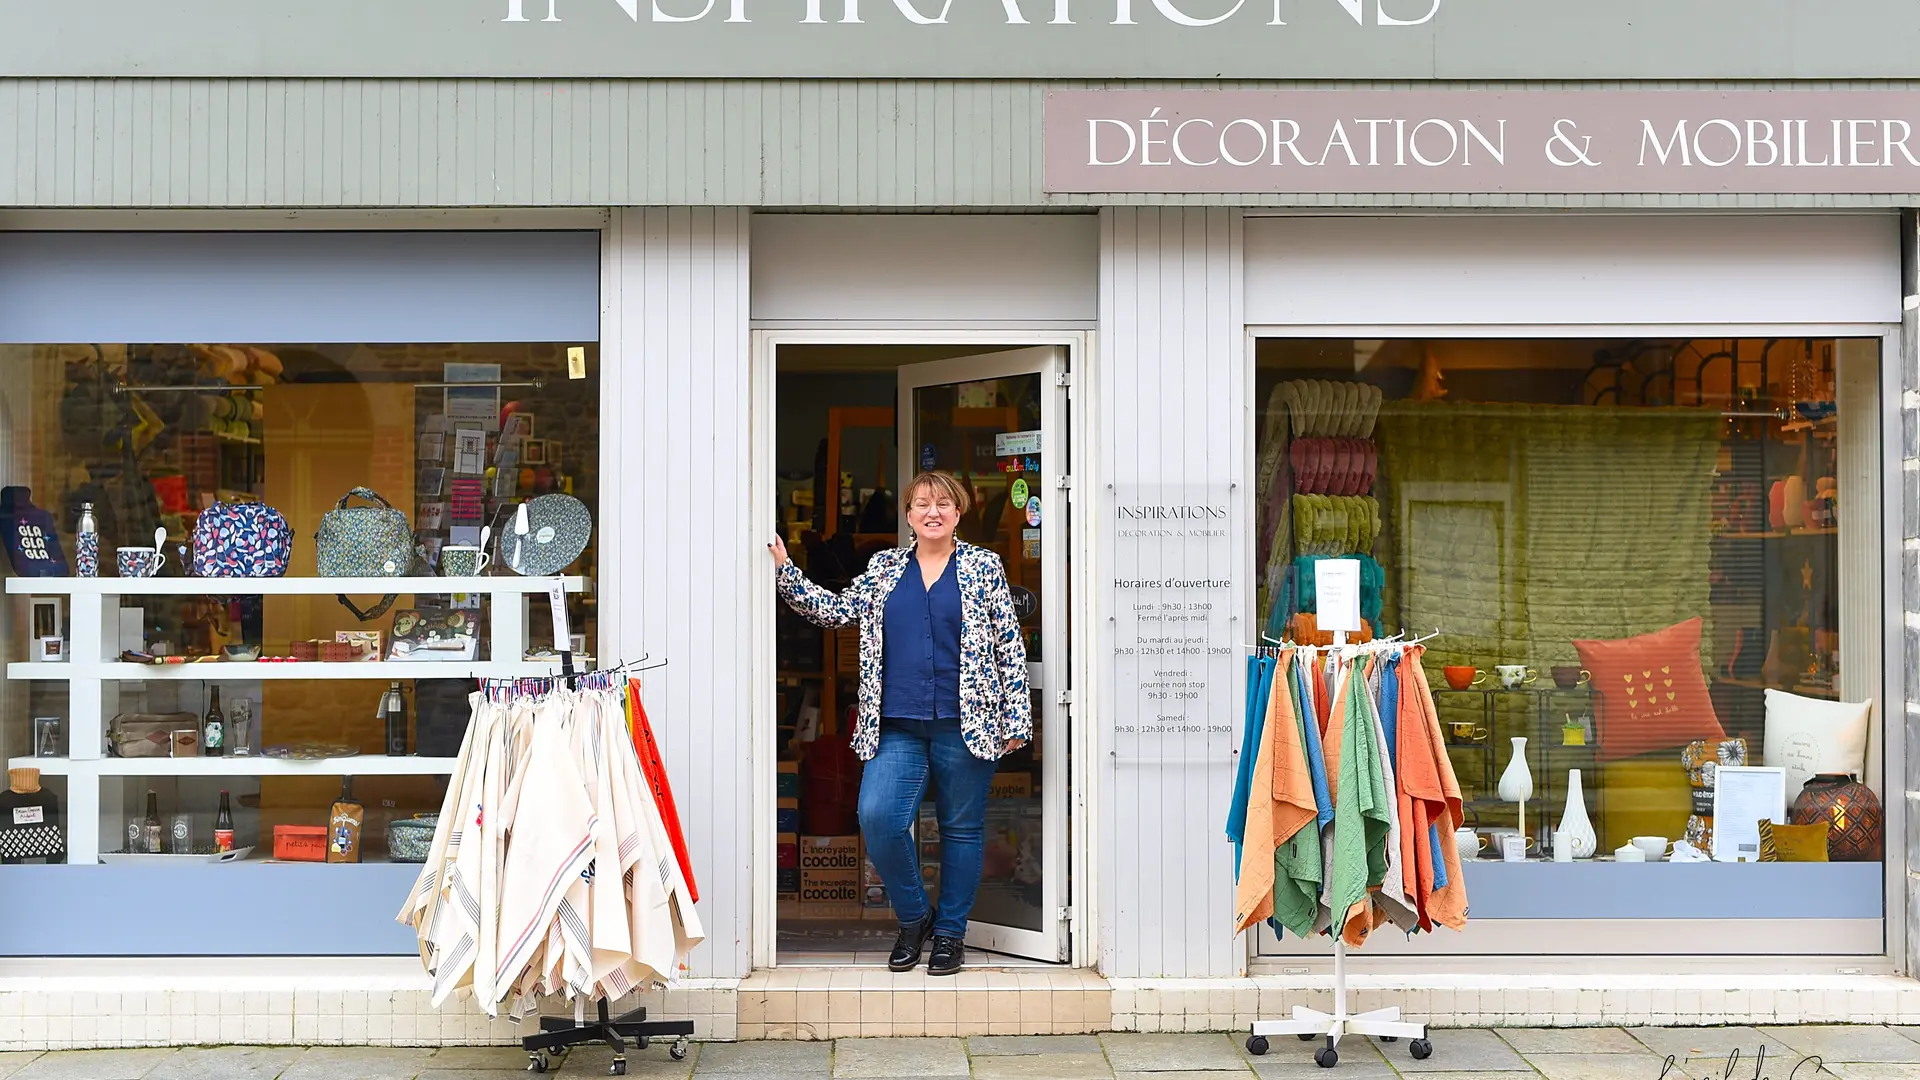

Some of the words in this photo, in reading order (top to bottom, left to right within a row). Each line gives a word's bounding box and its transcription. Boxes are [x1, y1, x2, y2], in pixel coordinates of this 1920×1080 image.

[1086, 106, 1506, 168] DÉCORATION
[1544, 118, 1600, 168] &
[1636, 118, 1920, 168] MOBILIER
[1118, 505, 1227, 519] INSPIRATIONS
[18, 525, 42, 537] GLA
[1118, 528, 1173, 537] DÉCORATION
[21, 537, 45, 549] GLA
[24, 548, 49, 560] GLA
[1114, 578, 1162, 588] Horaires
[1164, 577, 1231, 588] d'ouverture
[1133, 603, 1154, 611] Lundi
[1162, 603, 1182, 611] 9h30
[1188, 603, 1213, 611] 13h00
[1137, 613, 1162, 621] Fermé
[1163, 613, 1189, 623] l'après
[1137, 636, 1148, 644] Du
[1149, 636, 1172, 644] mardi
[1183, 636, 1204, 646] jeudi
[1114, 647, 1135, 656] 9h30
[1141, 647, 1165, 655] 12h30
[1176, 647, 1201, 655] 14h00
[1207, 647, 1232, 655] 19h00
[1153, 669, 1188, 677] Vendredi
[1139, 681, 1171, 690] journée
[1188, 681, 1206, 690] stop
[1147, 691, 1168, 699] 9h30
[1174, 691, 1199, 699] 19h00
[1156, 713, 1186, 722] Samedi
[1114, 725, 1135, 733] 9h30
[1141, 725, 1165, 733] 12h30
[1177, 725, 1201, 733] 14h00
[1207, 725, 1232, 733] 19h00
[988, 784, 1025, 797] oyable
[802, 846, 857, 855] L'Incroyable
[802, 854, 857, 867] cocotte
[803, 887, 857, 900] cocotte
